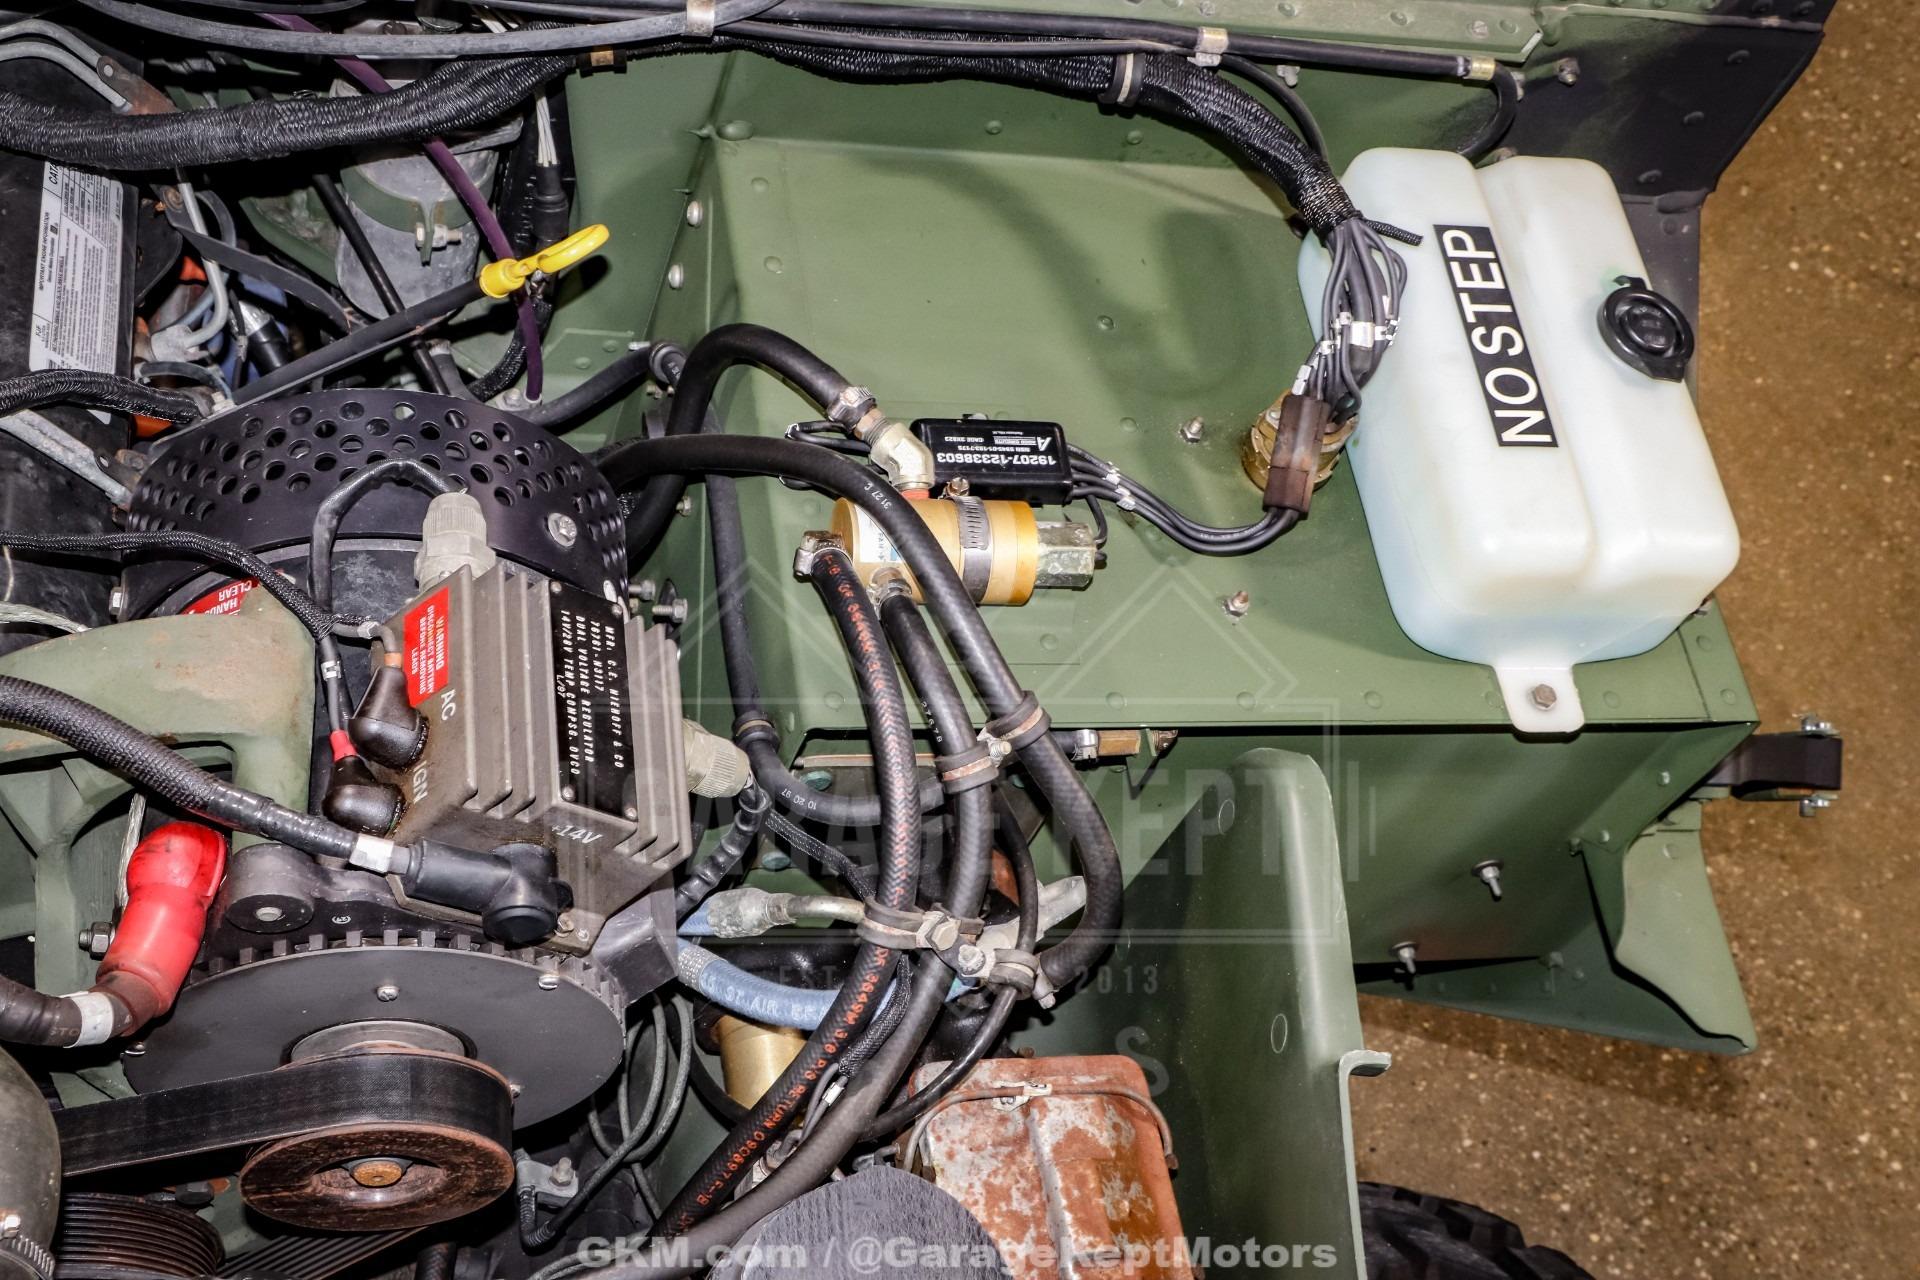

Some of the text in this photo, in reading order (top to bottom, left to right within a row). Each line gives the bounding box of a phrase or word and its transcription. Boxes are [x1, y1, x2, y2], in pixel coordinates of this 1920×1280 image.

[38, 263, 46, 291] IMPORTANT
[42, 211, 51, 244] INFORMATION
[1442, 229, 1552, 442] NO STEP
[936, 452, 1056, 465] 19207-12338603
[218, 580, 252, 601] CLEAR
[426, 605, 435, 660] DISCONNECT
[435, 616, 444, 670] WARNING
[419, 650, 427, 694] REMOVING
[564, 659, 574, 686] TEMP
[576, 616, 594, 762] DUAL VOLTAGE REGULATOR
[607, 660, 616, 680] C.E.
[441, 689, 456, 721] AC
[609, 689, 621, 734] NIEHOFF
[413, 760, 428, 804] IGN
[614, 755, 624, 768] CO
[780, 787, 817, 810] 10 20 97
[552, 824, 603, 844] +14V
[762, 1082, 806, 1129] RETURN
